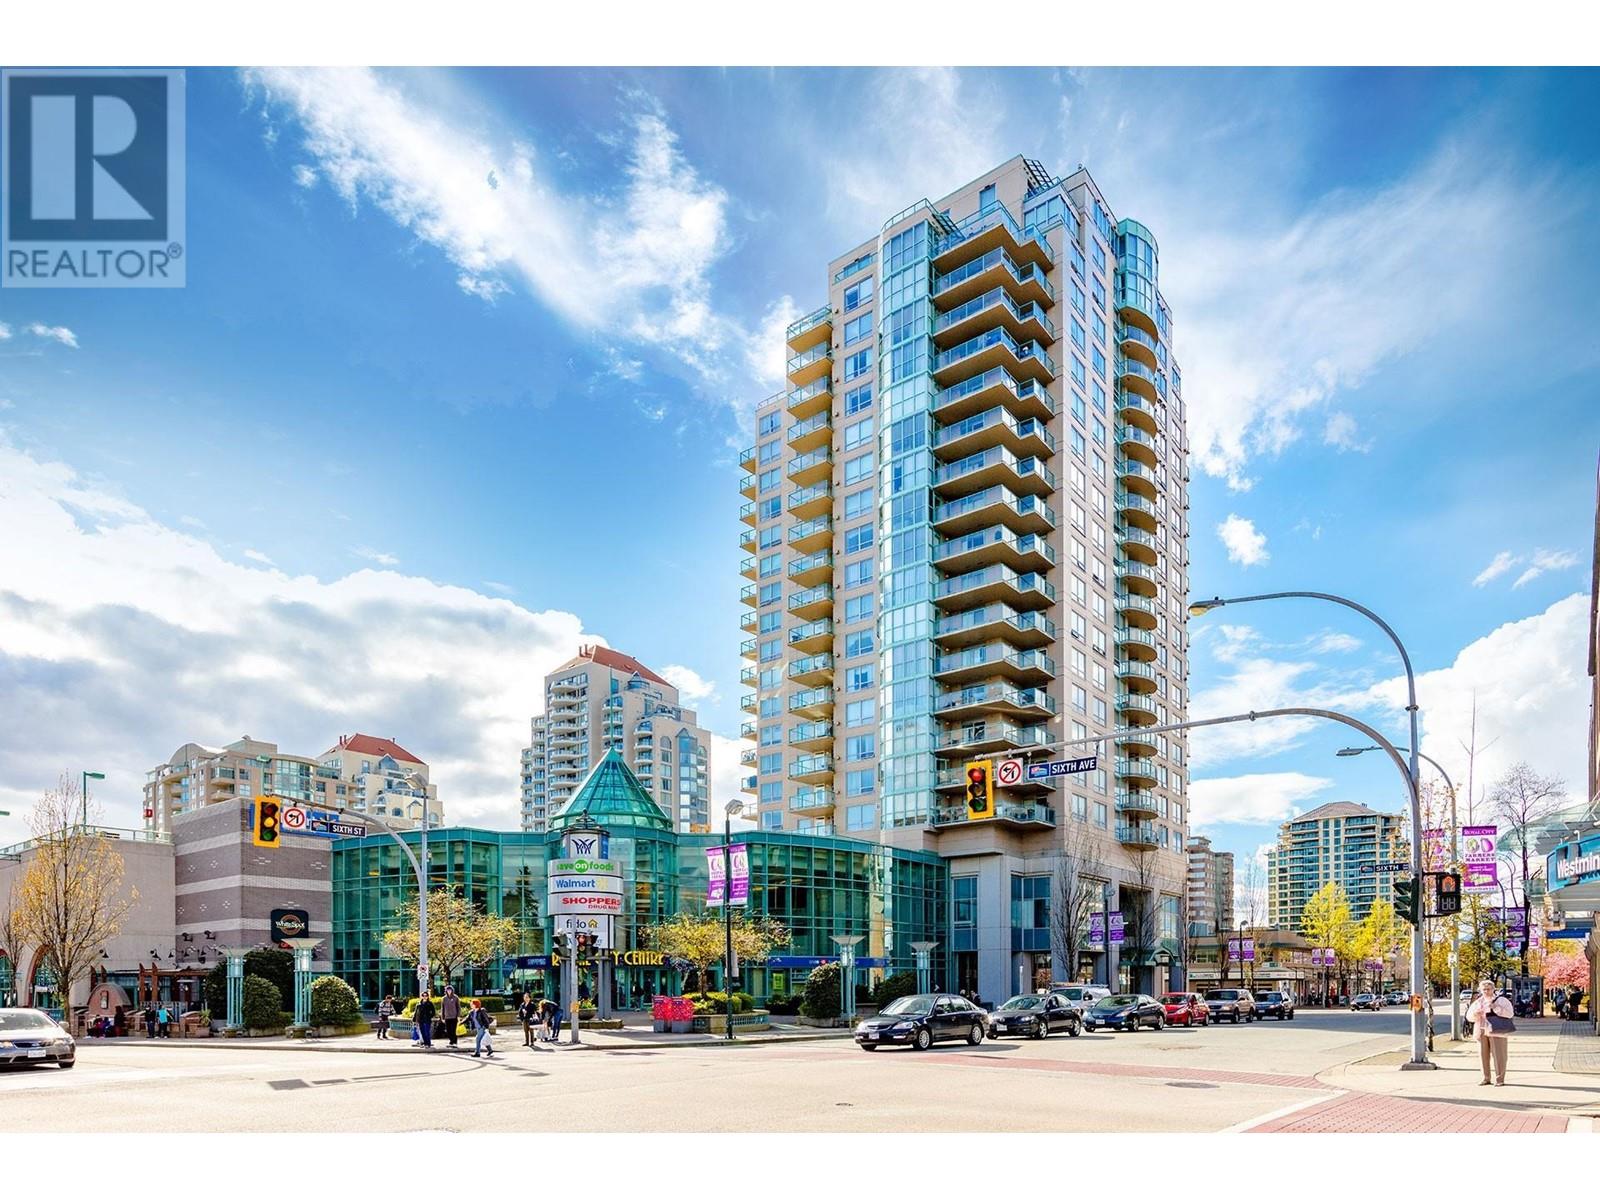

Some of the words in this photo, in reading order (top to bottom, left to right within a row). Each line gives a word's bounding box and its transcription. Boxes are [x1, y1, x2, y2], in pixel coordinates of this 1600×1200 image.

[1052, 762, 1077, 774] SIXTH
[1078, 759, 1095, 770] AVE
[332, 824, 353, 834] SIXTH
[353, 827, 363, 835] ST
[1375, 864, 1399, 872] SIXTH
[556, 879, 595, 889] Walmart
[562, 897, 621, 906] SHOPPERS
[624, 951, 665, 966] CENTRE
